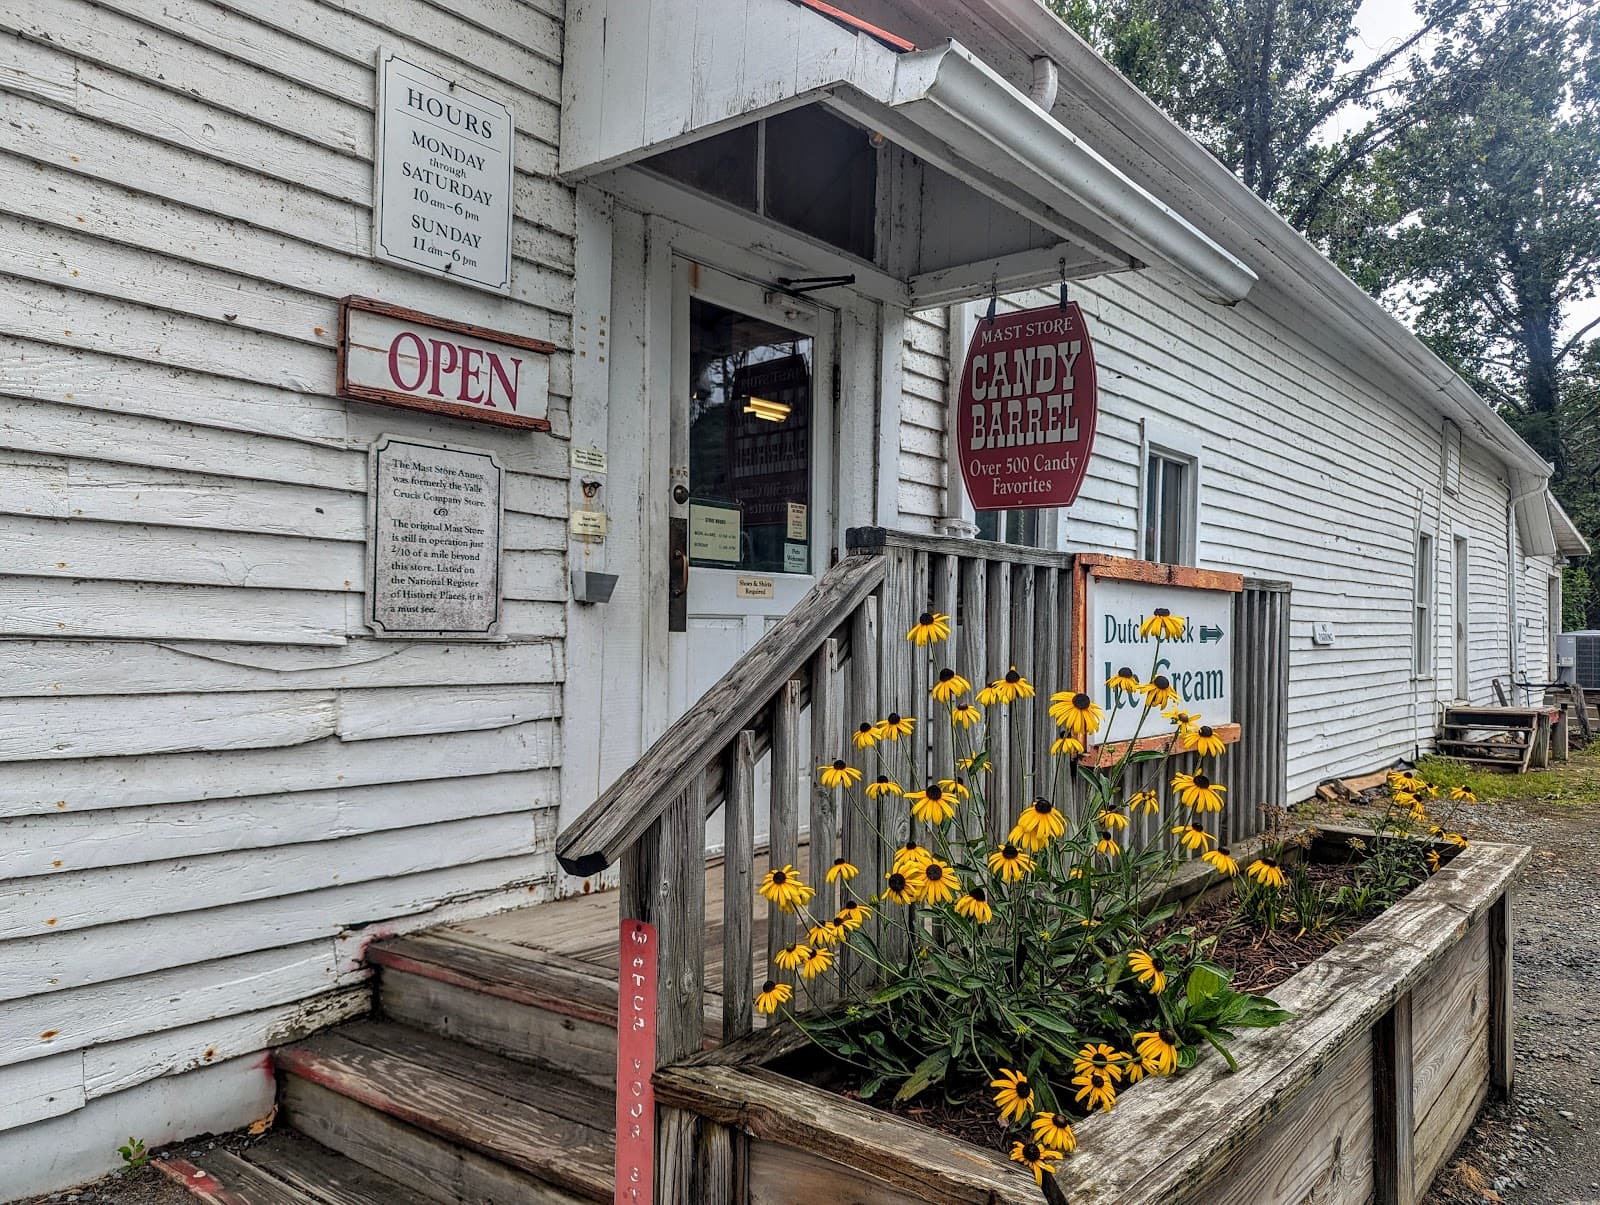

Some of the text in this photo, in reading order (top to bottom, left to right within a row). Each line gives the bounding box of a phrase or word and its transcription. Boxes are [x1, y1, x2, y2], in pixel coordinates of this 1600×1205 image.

[407, 88, 492, 139] HOURS
[412, 130, 485, 171] MONDAY
[429, 157, 467, 179] through
[402, 161, 492, 206] SATURDAY
[411, 214, 482, 249] SUNDAY
[980, 317, 1073, 347] MAST STORE
[388, 332, 522, 411] OPEN
[971, 340, 1081, 401] CANDY
[970, 393, 1079, 450] BARREL
[392, 459, 484, 480] The Mast Store Annex
[970, 451, 1078, 476] Over 500 Candy
[411, 476, 447, 490] formerly
[449, 481, 462, 490] the
[993, 475, 1052, 495] Favorites
[393, 489, 421, 500] Crucis
[423, 492, 462, 505] Company
[392, 519, 485, 535] The original Mast Store
[392, 533, 484, 548] is still in operation just
[391, 545, 411, 557] 2/10
[412, 549, 421, 557] of
[431, 551, 448, 559] mile
[451, 551, 480, 561] beyond
[391, 562, 408, 570] this
[437, 564, 462, 573] Listed
[391, 576, 479, 588] the National Register
[391, 589, 400, 598] of
[403, 590, 437, 599] Historic
[477, 593, 484, 601] is
[1104, 614, 1149, 644] Dutch
